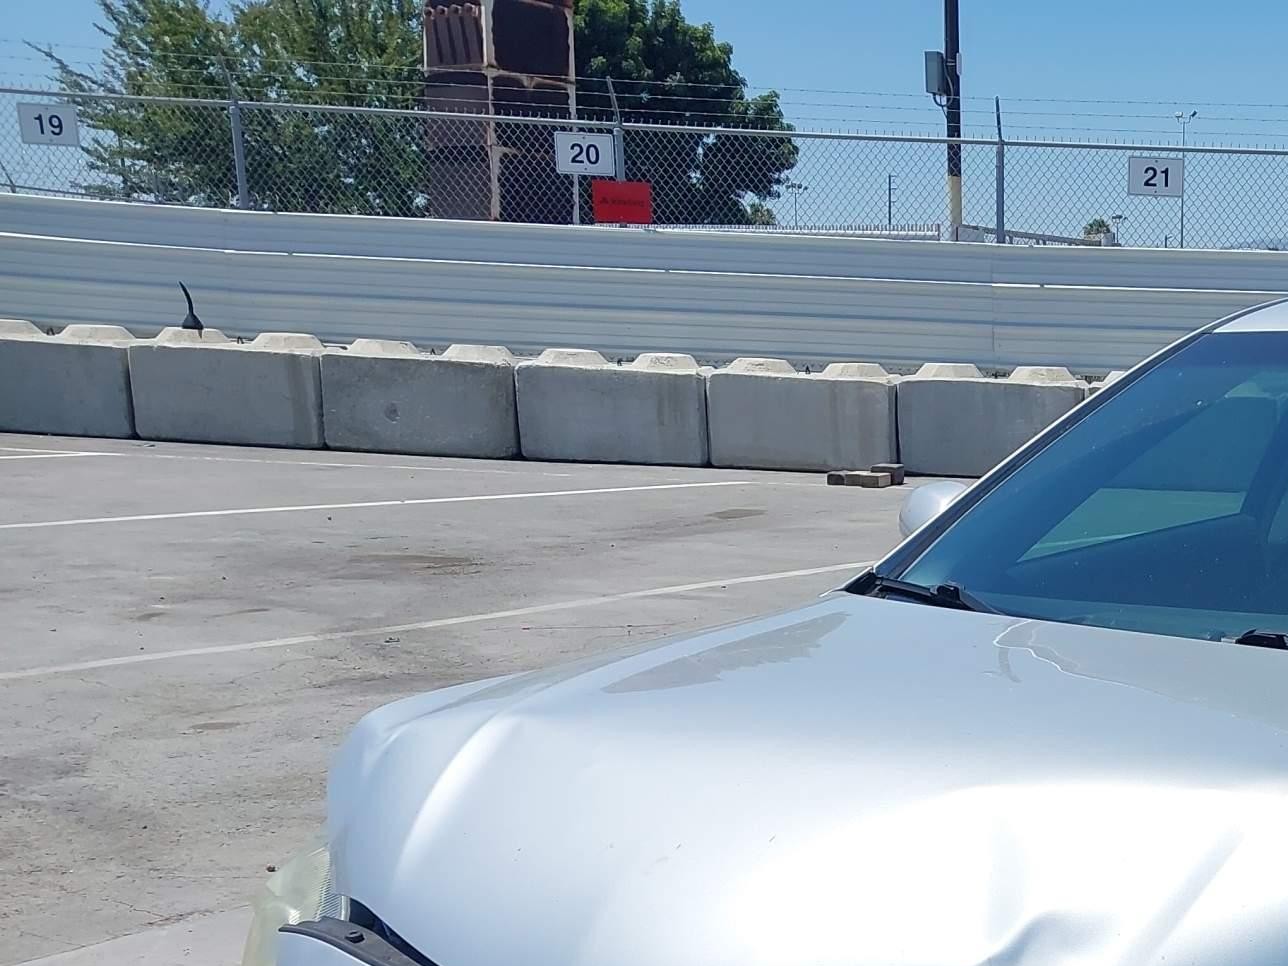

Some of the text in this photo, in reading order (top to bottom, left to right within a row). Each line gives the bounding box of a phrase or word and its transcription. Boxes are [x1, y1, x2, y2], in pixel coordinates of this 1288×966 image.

[33, 113, 64, 137] 19
[569, 142, 600, 165] 20
[1143, 166, 1170, 188] 21
